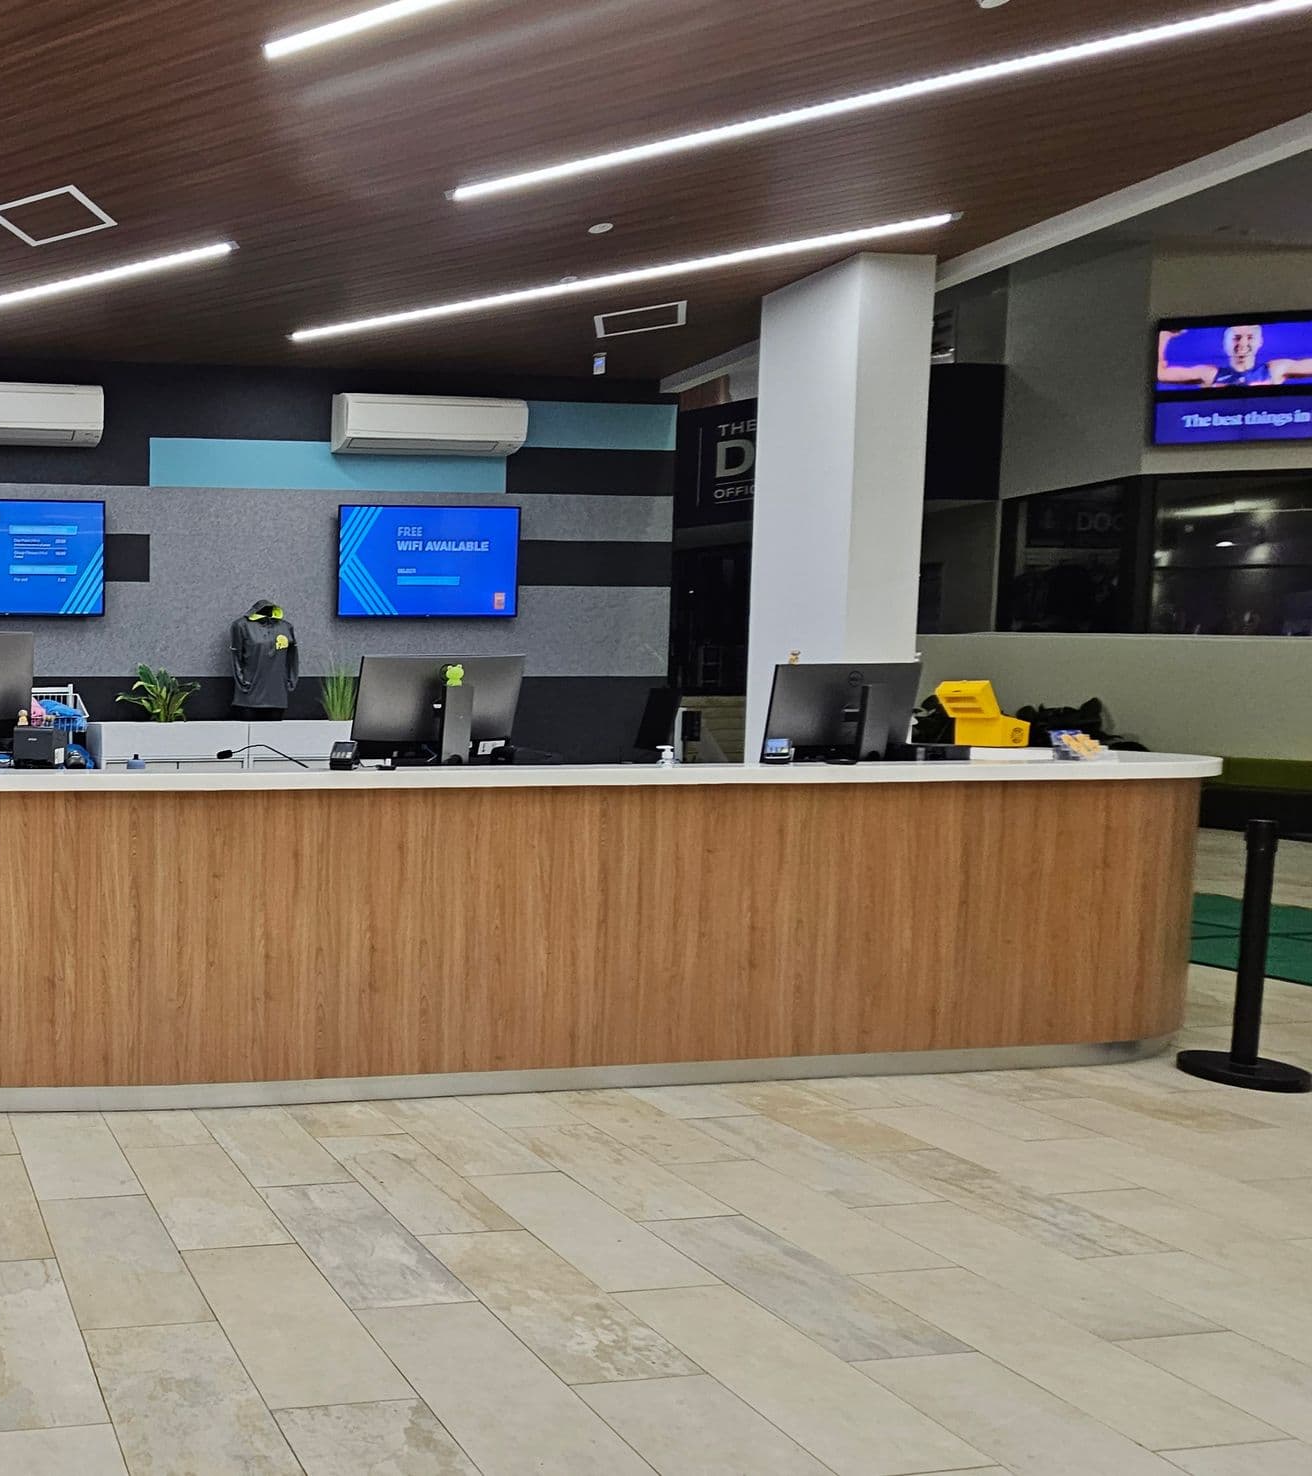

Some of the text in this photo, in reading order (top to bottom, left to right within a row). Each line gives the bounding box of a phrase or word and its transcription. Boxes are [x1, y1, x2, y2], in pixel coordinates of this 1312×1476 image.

[1182, 414, 1212, 427] The
[1212, 413, 1243, 426] best
[1244, 411, 1293, 426] things
[717, 419, 757, 437] THE
[715, 439, 755, 478] D
[713, 485, 755, 499] OFFIC
[1076, 510, 1125, 534] DOC
[397, 526, 423, 537] FREE
[396, 540, 490, 552] WIFI AVAILABLE
